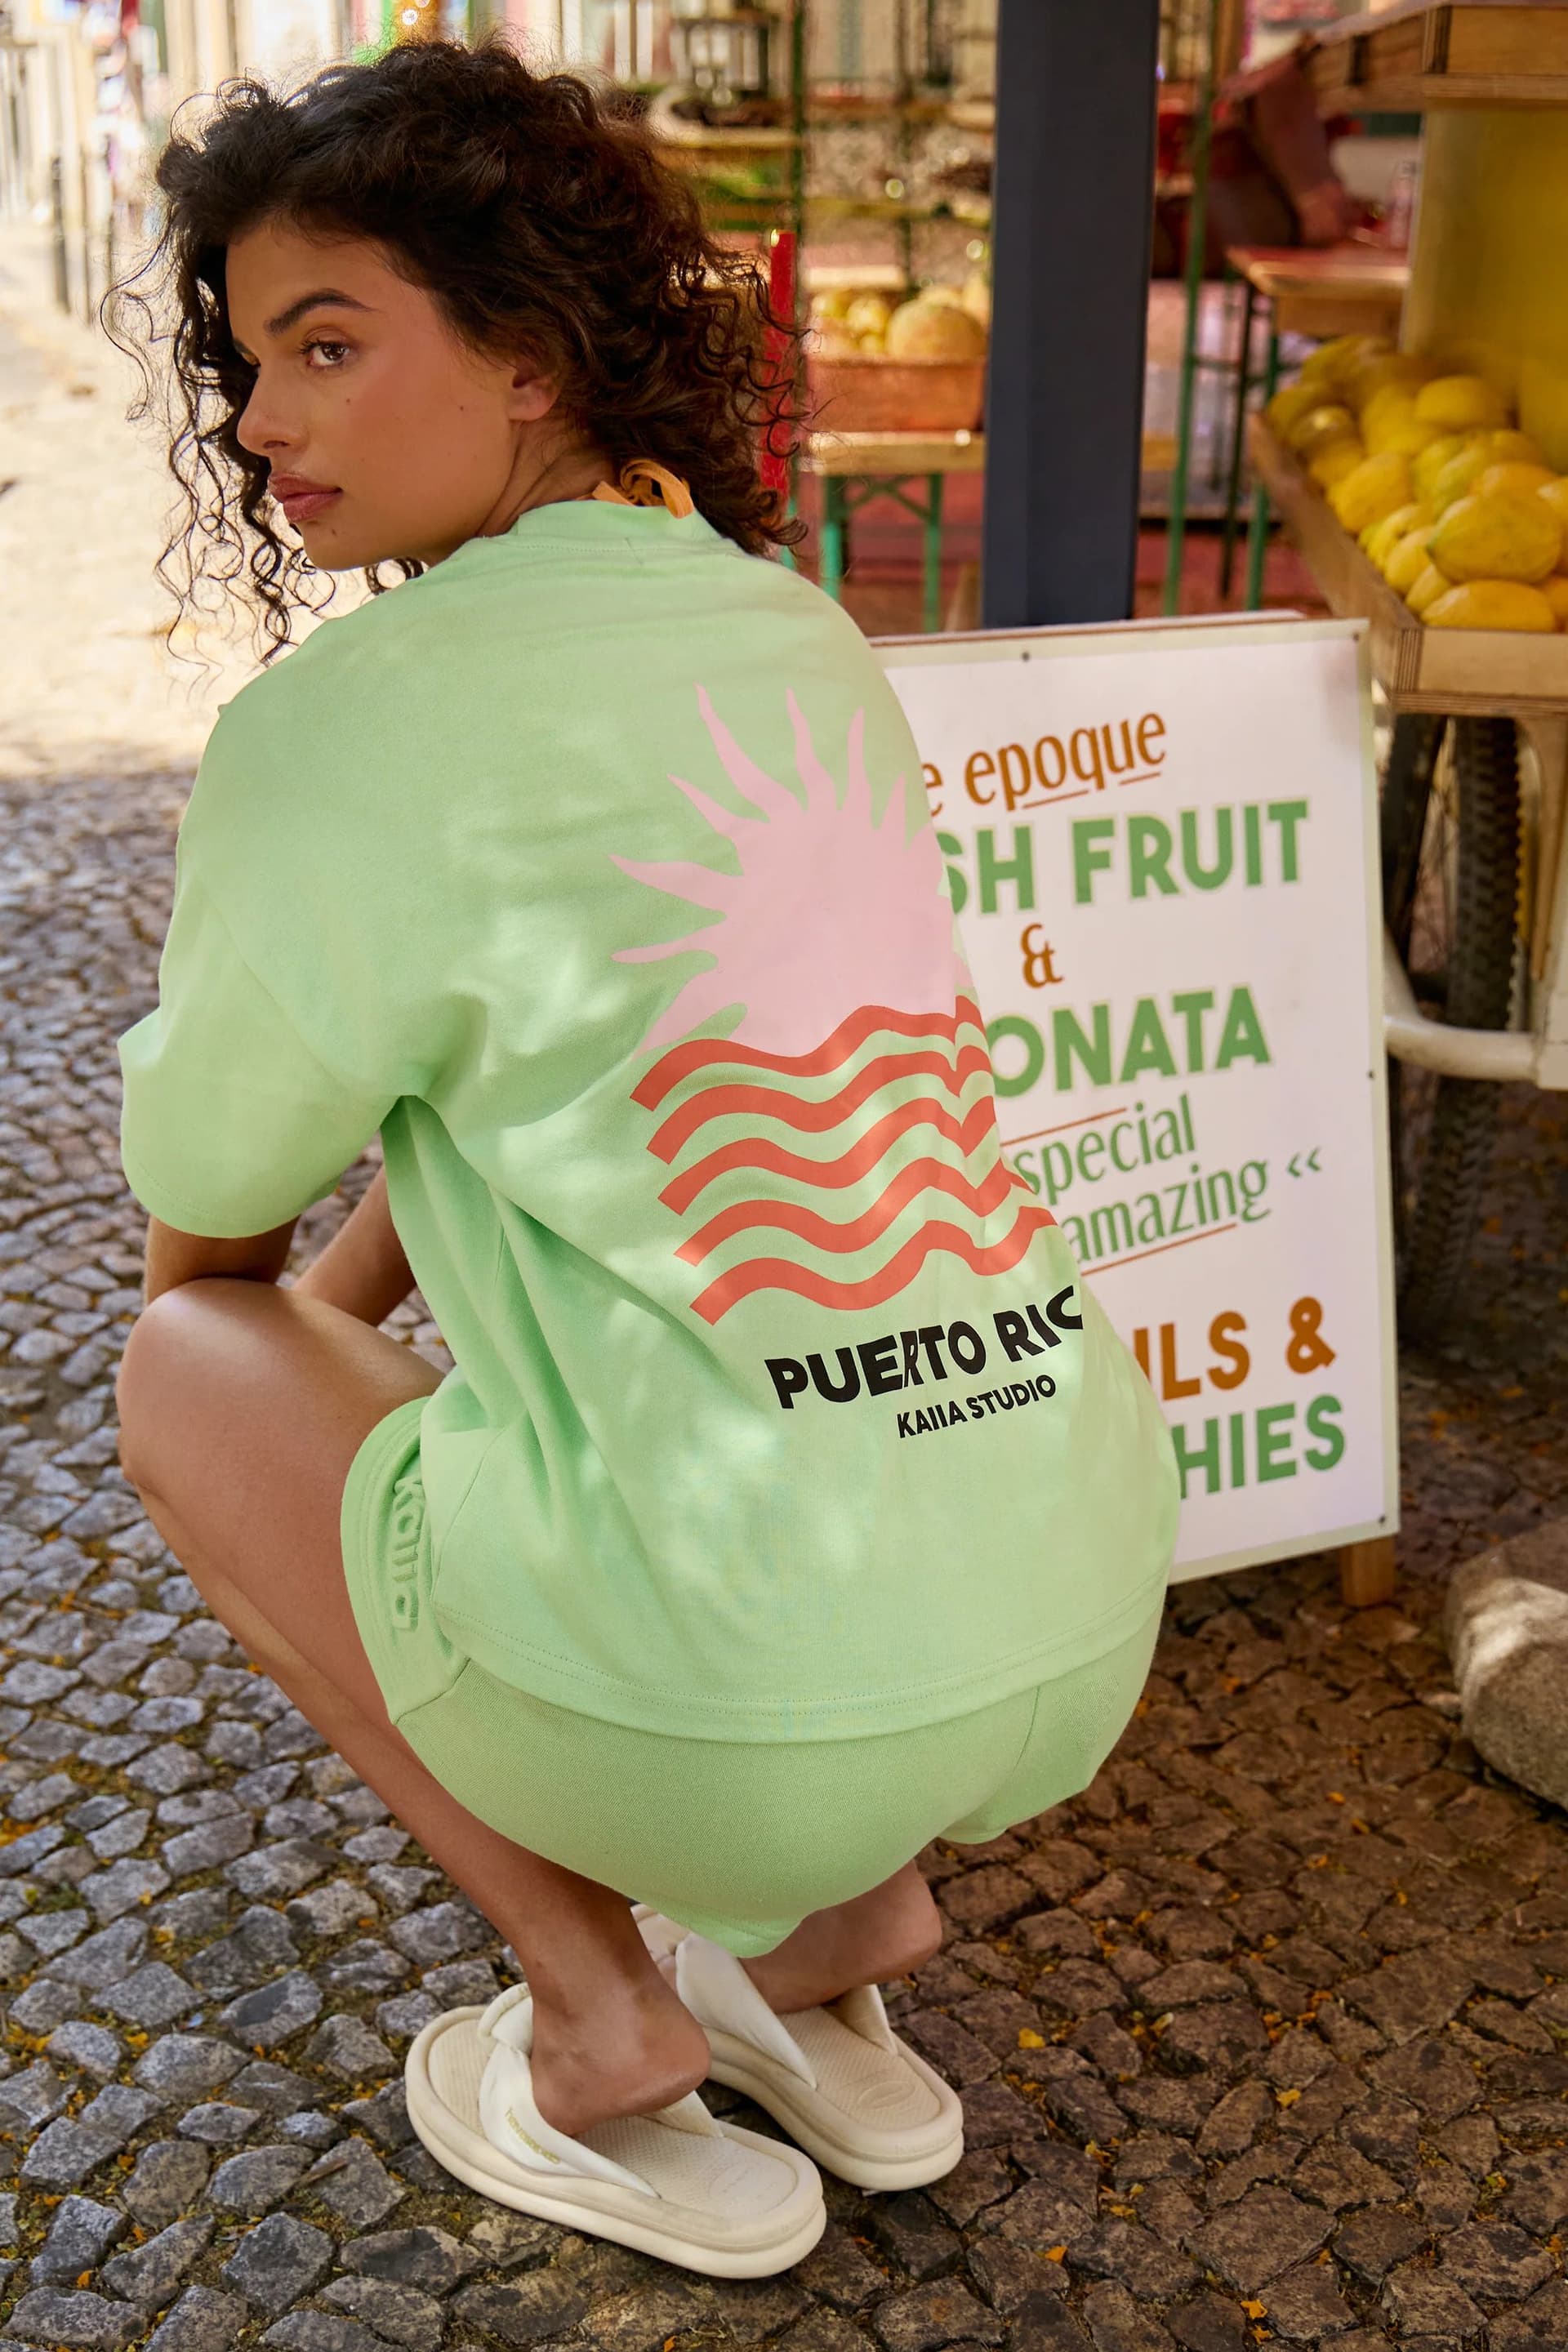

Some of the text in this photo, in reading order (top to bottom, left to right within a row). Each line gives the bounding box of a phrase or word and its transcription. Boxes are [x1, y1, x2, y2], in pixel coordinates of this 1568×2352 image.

[964, 713, 1166, 812] epoque
[1071, 800, 1309, 904] FRUIT
[1019, 923, 1063, 990] &
[986, 986, 1272, 1098] ONATA
[1013, 1091, 1196, 1206] special
[1062, 1159, 1271, 1263] amazing
[764, 1321, 987, 1410] PUERTO
[1285, 1296, 1337, 1374] &
[897, 1374, 1057, 1439] KAIIA STUDIO
[1169, 1395, 1346, 1499] HIES
